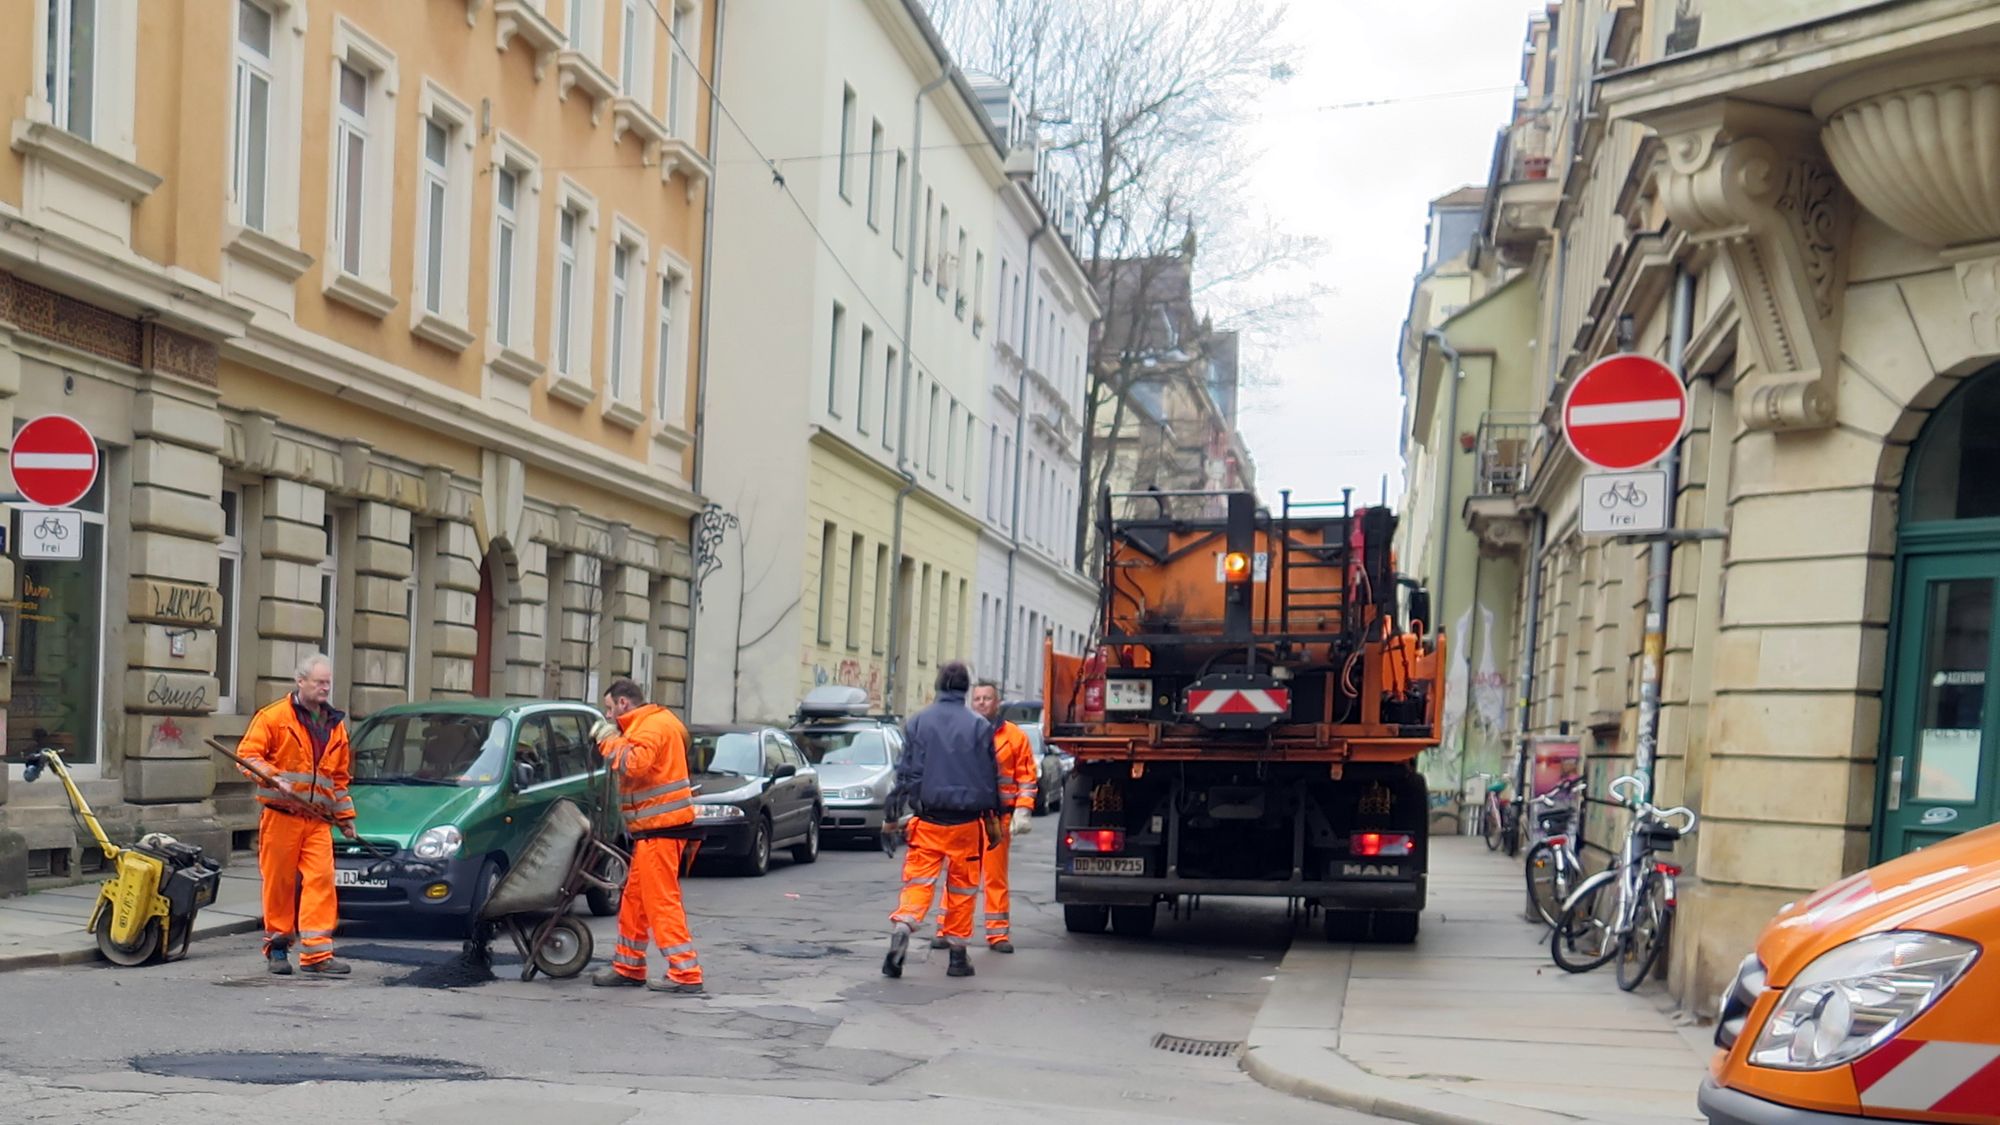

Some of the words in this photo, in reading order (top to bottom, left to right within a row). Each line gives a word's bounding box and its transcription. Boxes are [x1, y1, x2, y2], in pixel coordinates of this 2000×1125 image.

[1610, 513, 1636, 525] frei
[41, 542, 61, 553] frei
[1075, 859, 1089, 871] DD
[1114, 860, 1142, 872] 9215
[1343, 863, 1399, 876] MAN
